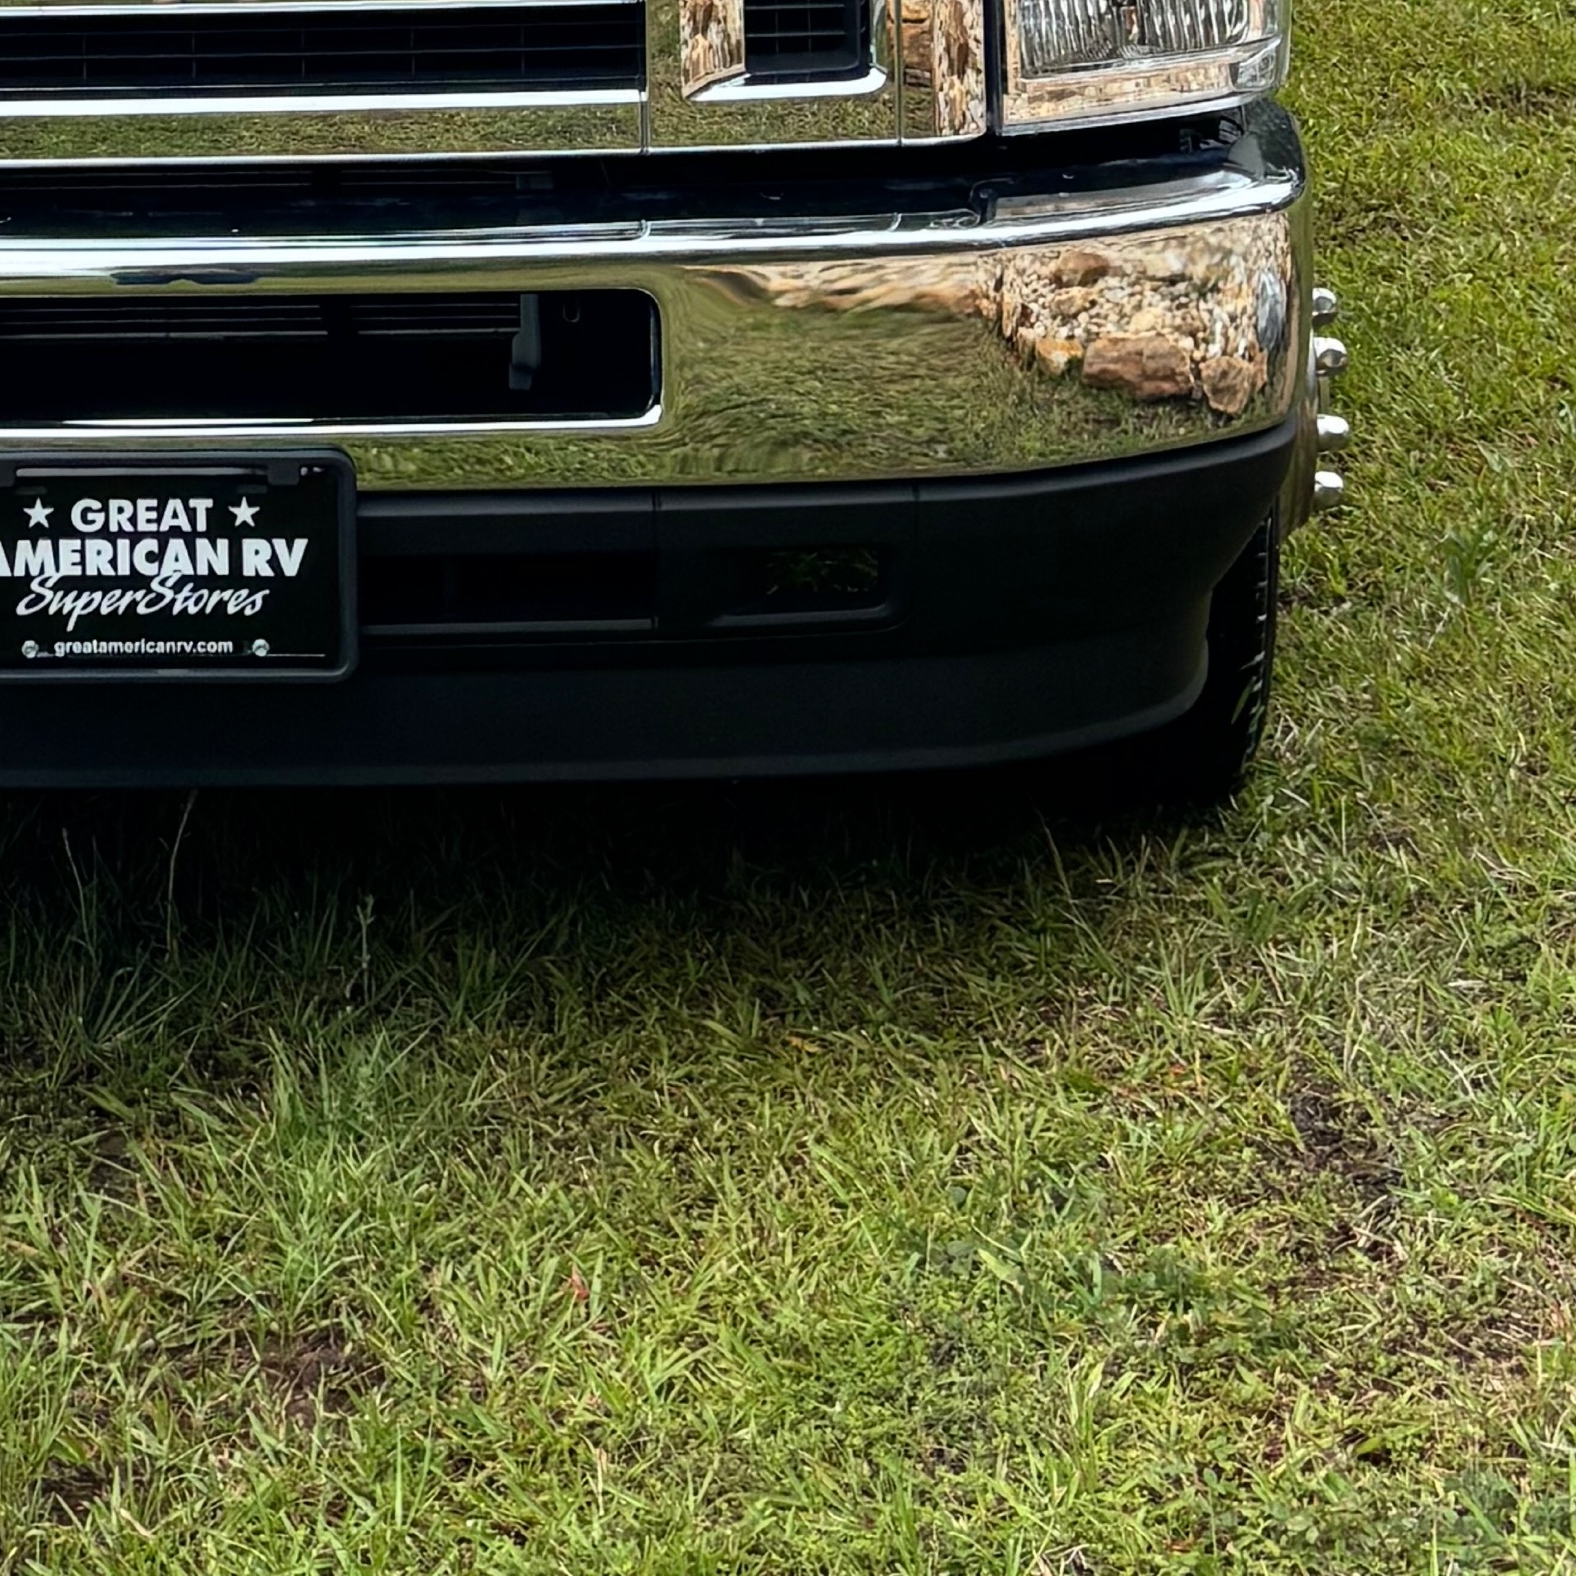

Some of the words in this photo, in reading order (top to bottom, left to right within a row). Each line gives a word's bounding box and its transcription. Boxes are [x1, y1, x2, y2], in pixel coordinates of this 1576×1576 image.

[70, 498, 214, 533] GREAT
[241, 537, 309, 578] RV
[15, 572, 270, 633] SuperStores
[53, 637, 235, 657] greatamericanrv.com
